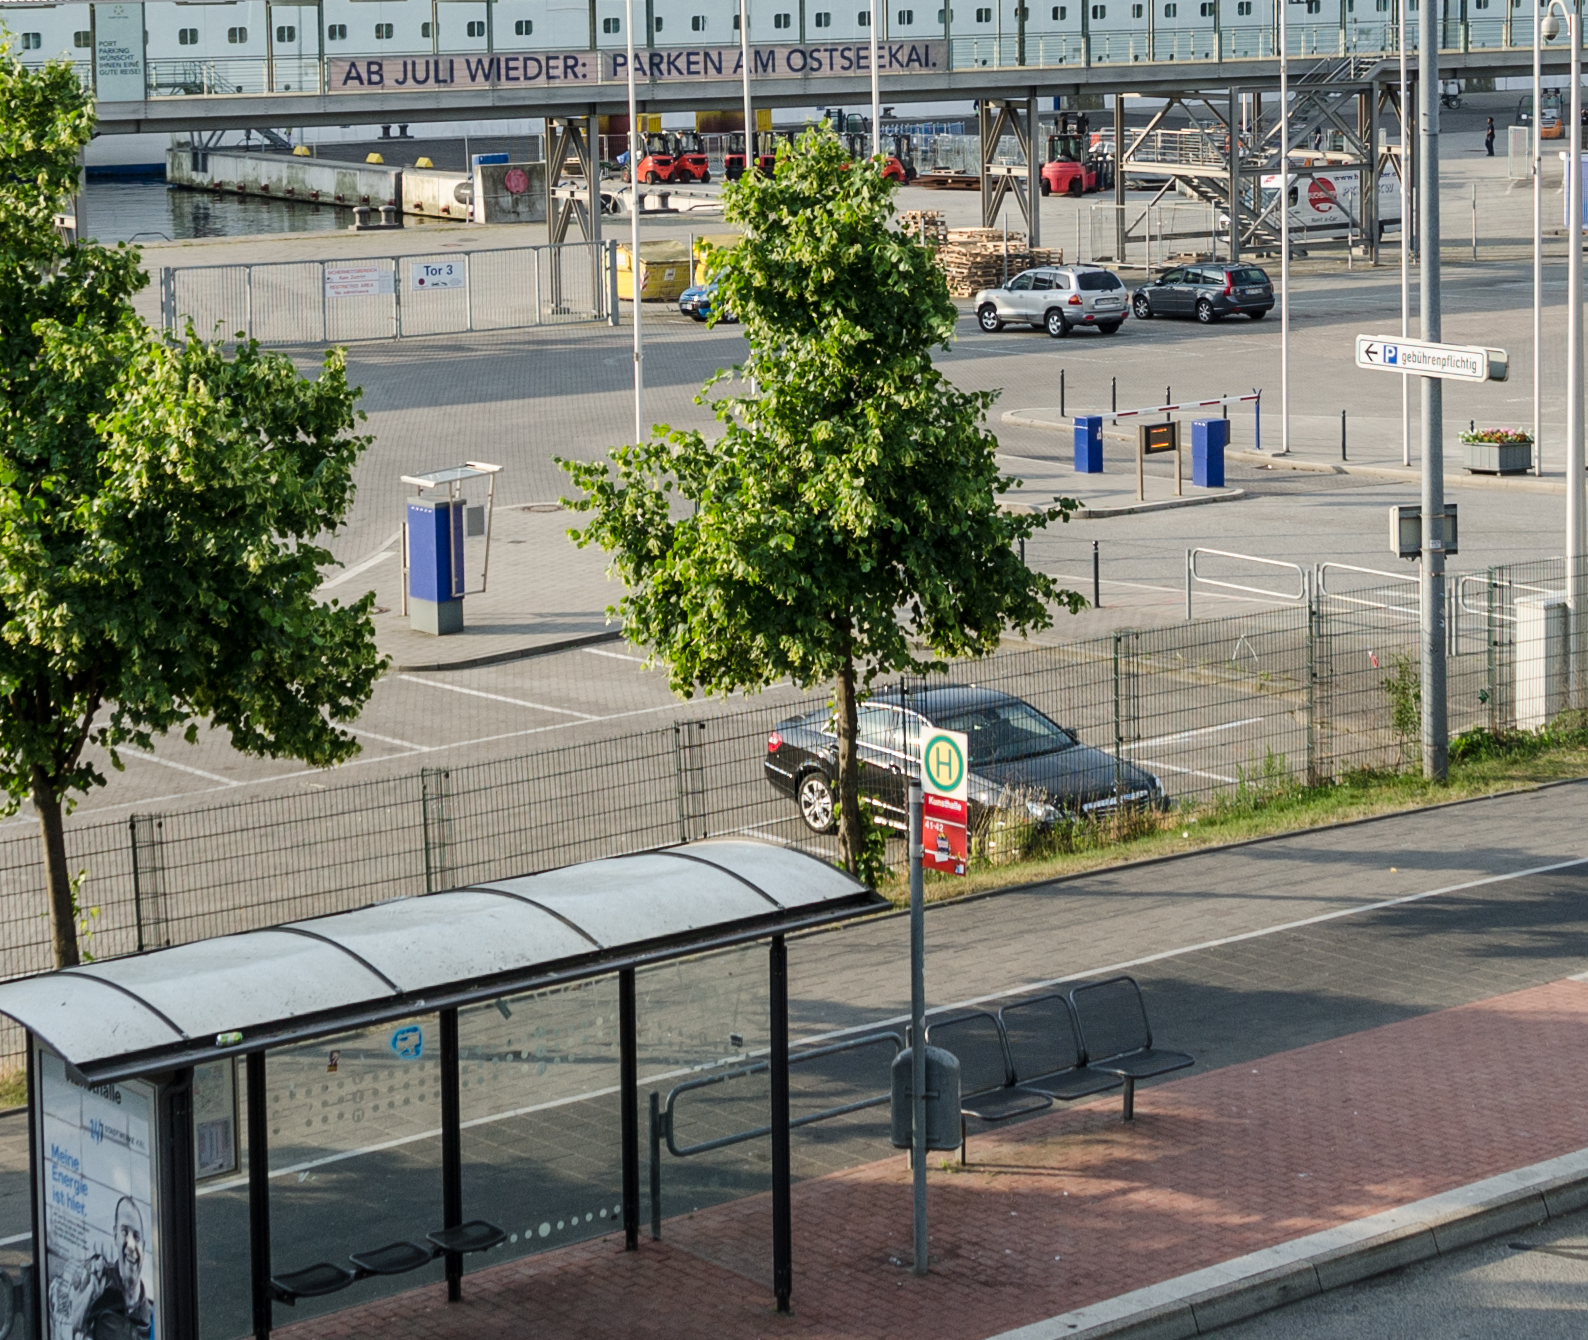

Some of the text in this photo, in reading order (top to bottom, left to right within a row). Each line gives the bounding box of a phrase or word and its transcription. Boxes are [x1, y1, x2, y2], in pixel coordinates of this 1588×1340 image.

[342, 59, 384, 86] AB
[394, 57, 455, 86] JULI
[465, 54, 588, 83] WIEDER:
[612, 50, 723, 77] PARKEN
[786, 44, 937, 73] OSTSEEKAI.
[423, 264, 453, 276] Tor 3
[1402, 350, 1478, 374] gebührenpflichtig
[936, 747, 952, 781] H
[51, 1143, 80, 1171] Meine
[52, 1164, 89, 1196] Energie
[52, 1184, 64, 1206] ist
